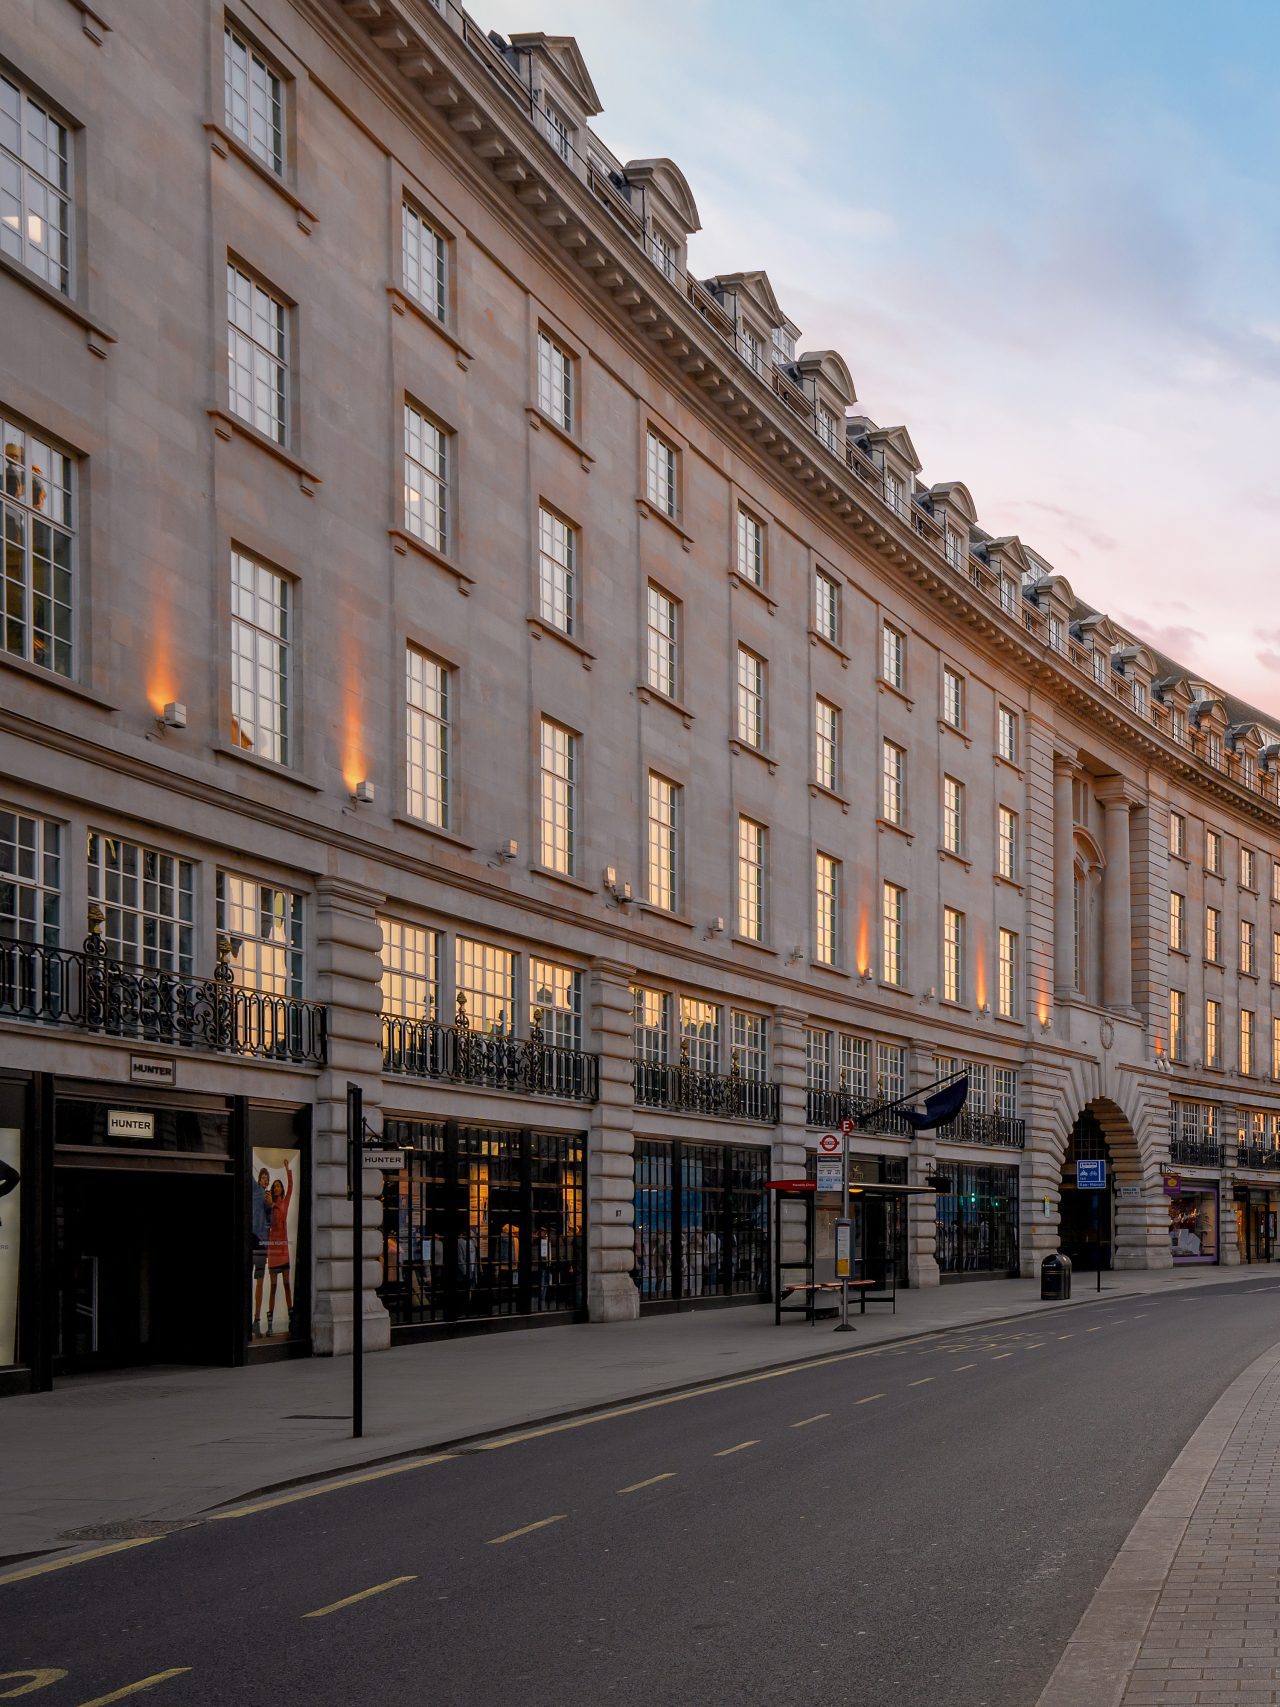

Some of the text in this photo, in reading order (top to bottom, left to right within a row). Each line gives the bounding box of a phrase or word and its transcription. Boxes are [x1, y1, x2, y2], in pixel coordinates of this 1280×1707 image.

[133, 1062, 172, 1076] HUNTER
[111, 1118, 151, 1130] HUNTER
[843, 1120, 850, 1131] E
[364, 1155, 402, 1163] HUNTER
